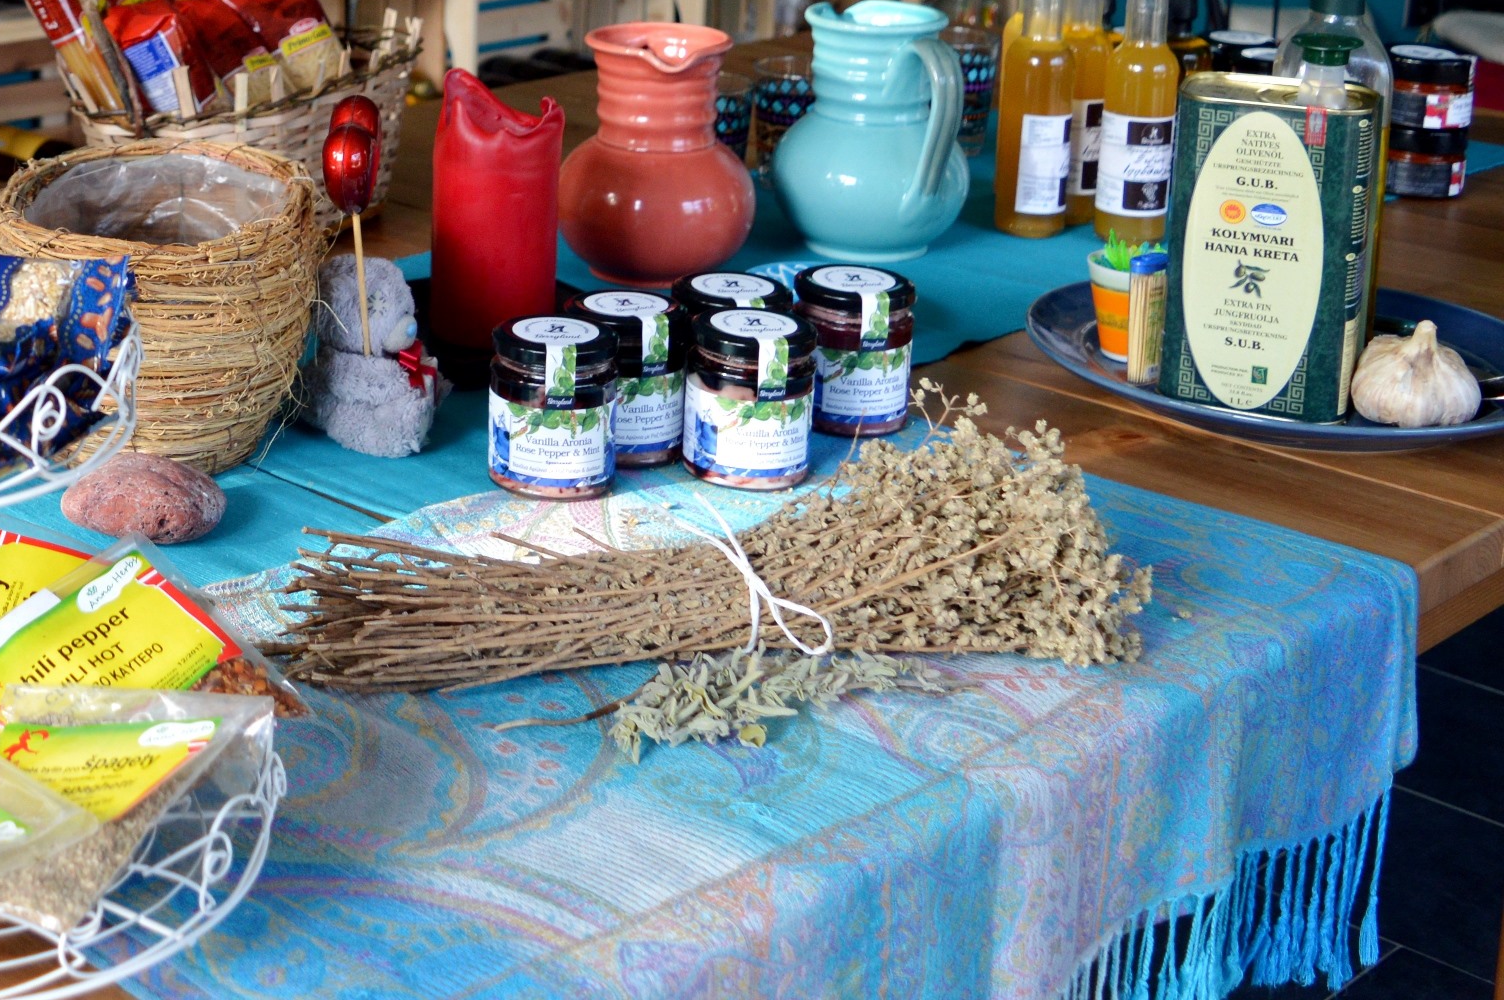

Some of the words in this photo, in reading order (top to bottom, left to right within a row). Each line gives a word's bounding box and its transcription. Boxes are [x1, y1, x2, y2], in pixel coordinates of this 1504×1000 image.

[46, 21, 58, 30] 3
[1246, 130, 1277, 140] EXTRA
[1241, 138, 1281, 150] NATIVES
[1236, 176, 1279, 190] G.U.B.
[1211, 228, 1295, 247] KOLYMVARI
[1205, 241, 1248, 256] HANIA
[1253, 248, 1300, 262] KRETA
[1223, 299, 1253, 310] EXTRA
[1256, 303, 1272, 311] FIN
[1214, 308, 1280, 324] JUNGFRUOLJA
[1229, 320, 1262, 329] SKYDDAD
[1224, 337, 1265, 351] S.U.B.
[840, 376, 873, 386] Vanilla
[875, 375, 900, 385] Aronia
[829, 385, 851, 394] Rose
[853, 387, 883, 396] Pepper
[622, 403, 654, 414] Vanilla
[656, 399, 679, 411] Aronia
[635, 414, 663, 425] Pepper
[526, 435, 561, 447] Vanilla
[562, 437, 593, 447] Aronia
[782, 438, 788, 446] &
[515, 443, 536, 456] Rose
[538, 446, 572, 459] Pepper
[573, 447, 580, 456] &
[89, 583, 114, 609] Anna
[112, 557, 139, 583] Herbs
[57, 606, 130, 662] pepper
[87, 641, 125, 667] HOT
[177, 642, 205, 666] 12/2017
[84, 753, 162, 773] špagety
